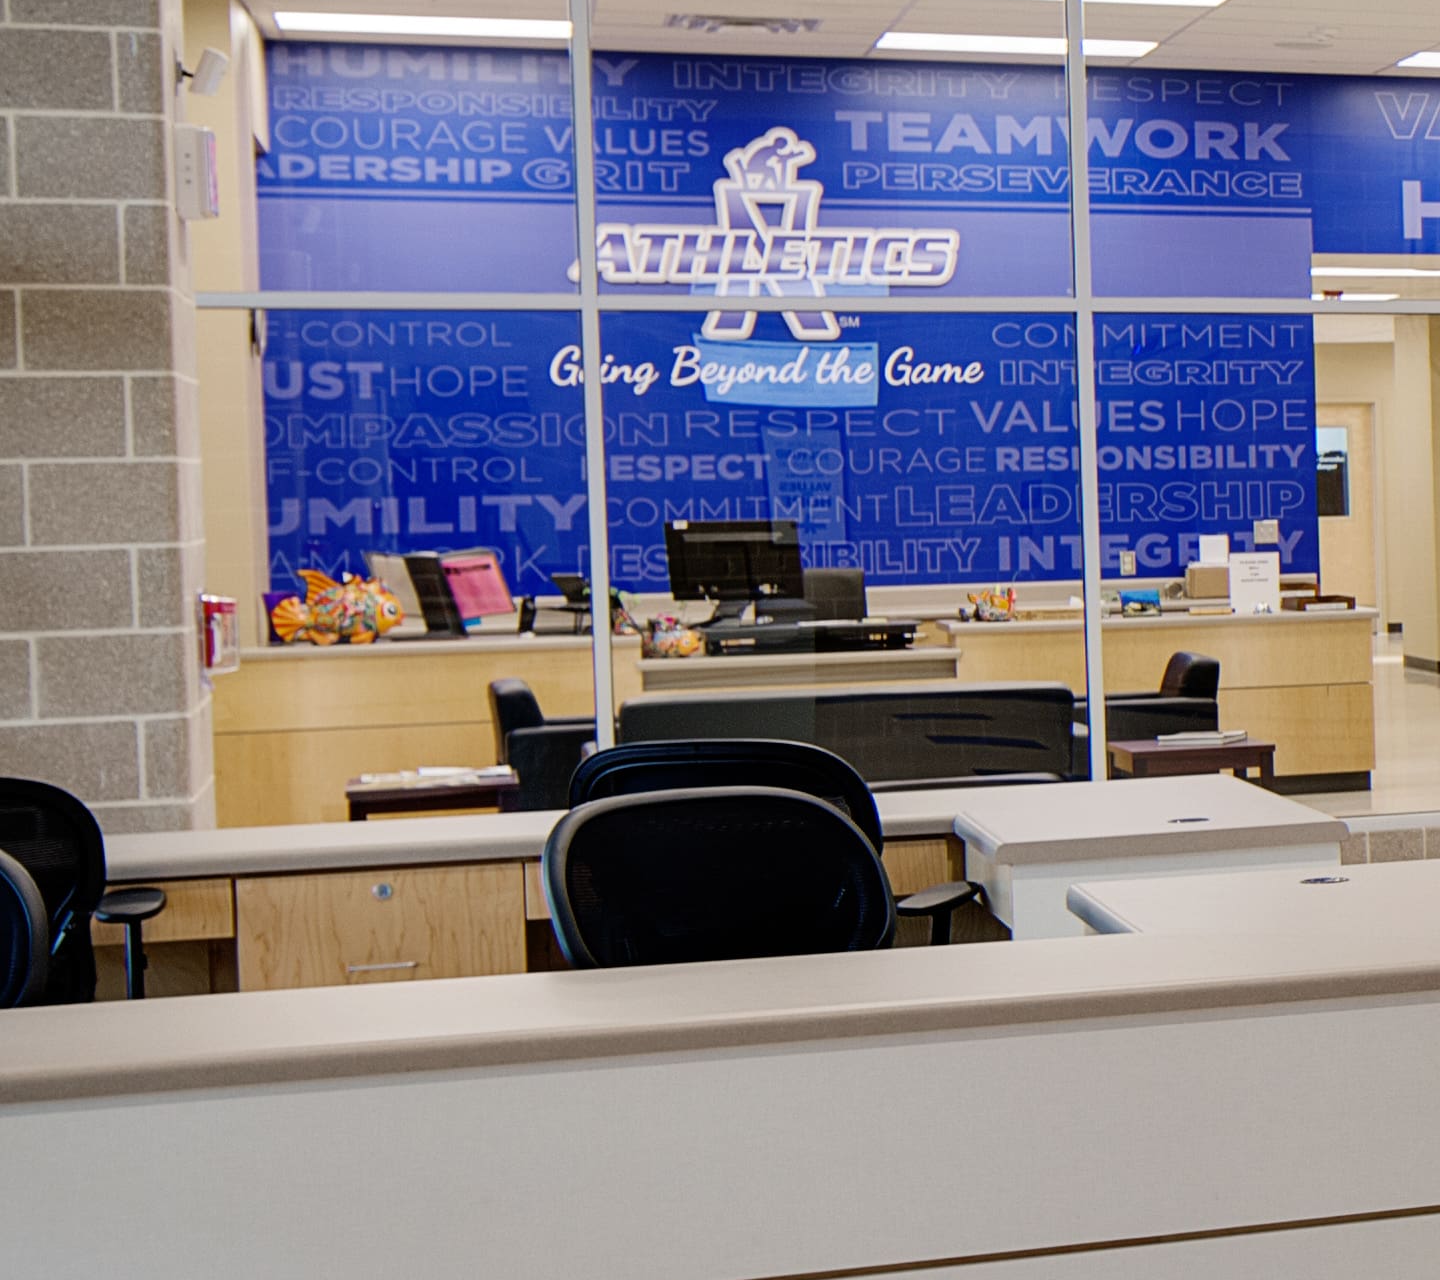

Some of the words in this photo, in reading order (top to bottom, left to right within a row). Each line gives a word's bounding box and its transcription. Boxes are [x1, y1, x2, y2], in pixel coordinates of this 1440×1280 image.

[672, 60, 1021, 99] INTEGRITY
[1054, 72, 1294, 107] ESPECT
[274, 115, 528, 154] COURAGE
[543, 124, 710, 157] VLUES
[835, 110, 1291, 162] TEAMWORK
[256, 152, 512, 184] ADERSHIP
[521, 157, 690, 192] GRIT
[843, 161, 1303, 198] PERSEVERANCE
[566, 223, 960, 287] ATHLETICS
[267, 320, 512, 349] F-CONTROL
[264, 360, 383, 400] UST
[390, 365, 528, 398] HOPE
[549, 345, 659, 396] Ging
[670, 345, 812, 396] Beyond
[815, 346, 875, 385] the
[884, 346, 985, 386] Game
[265, 411, 668, 448] OMPASSION
[685, 409, 957, 438] RESPECT
[1176, 399, 1308, 432] HOPE
[268, 456, 544, 485] F-CONTROL
[581, 454, 770, 482] ESPECT
[787, 447, 987, 474] COURAGE
[268, 493, 588, 537] UMILITY
[999, 530, 1304, 573] INTEGRTY
